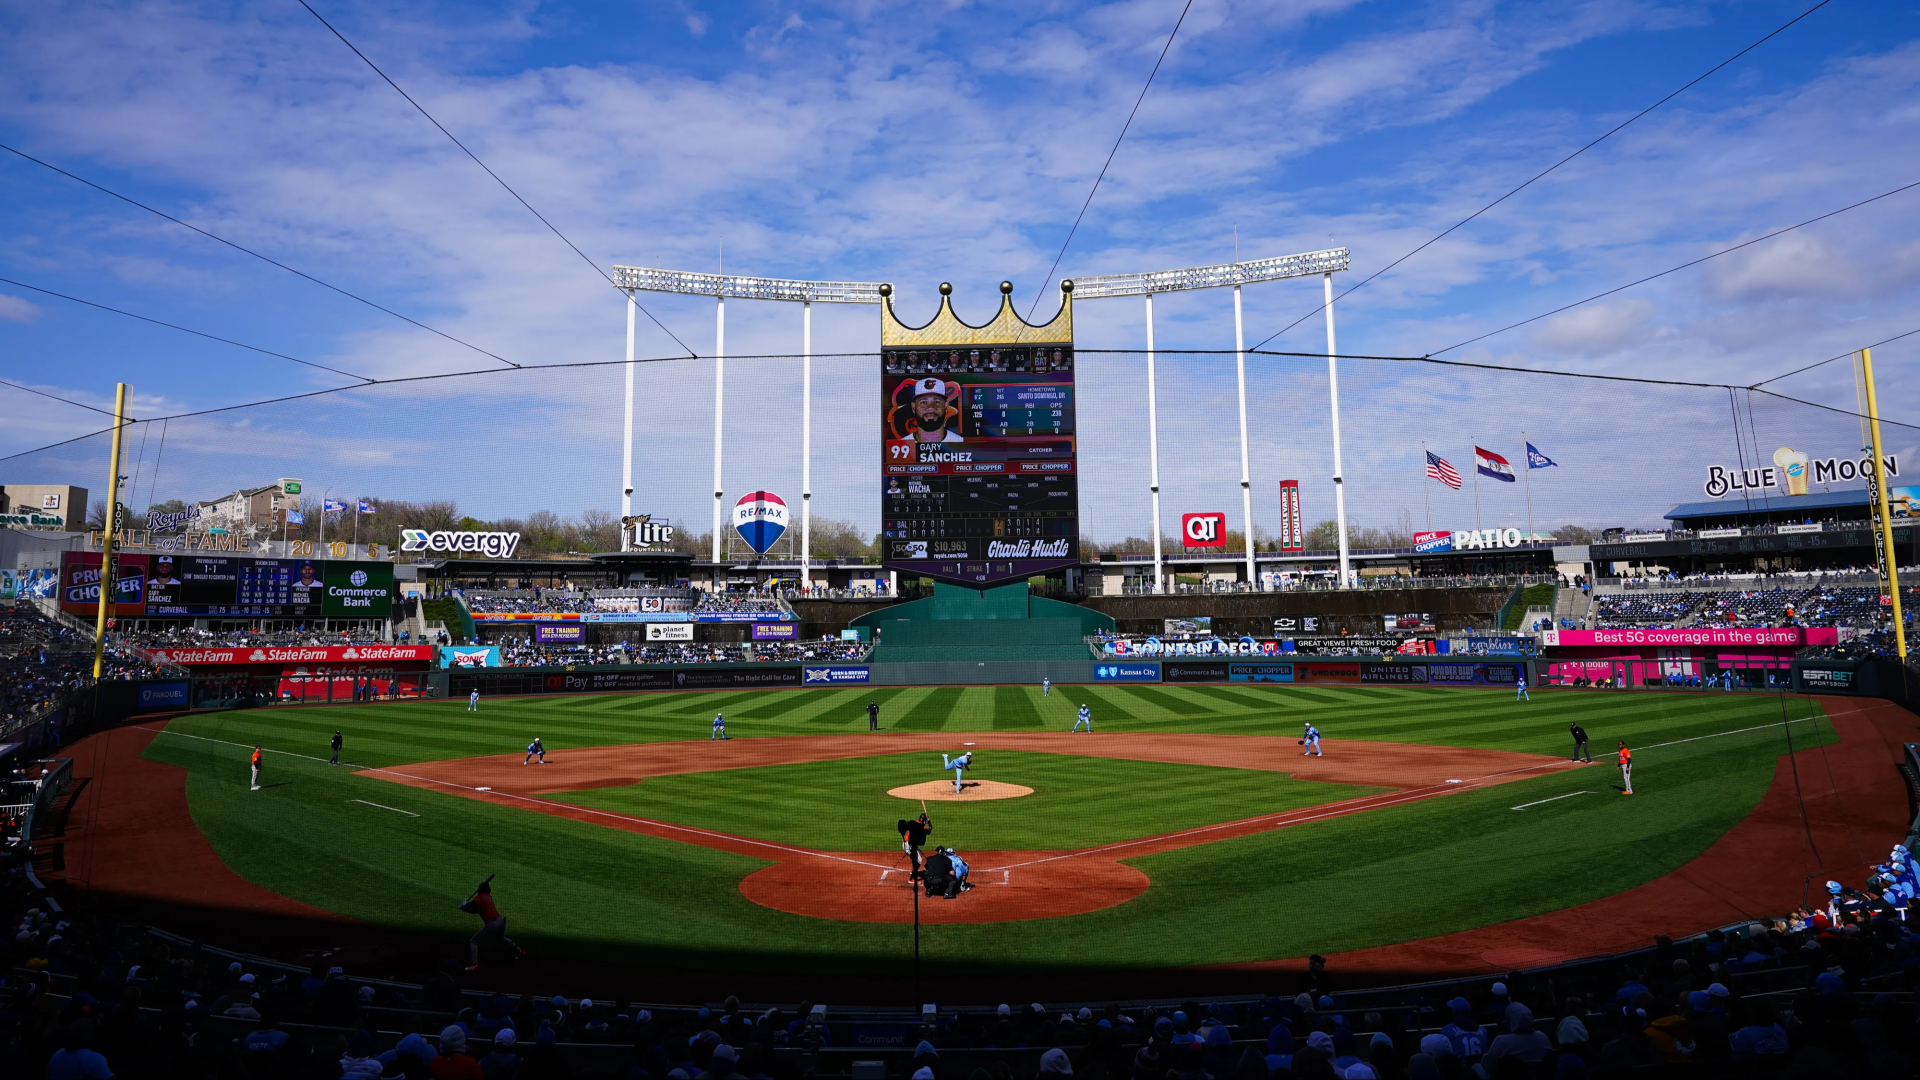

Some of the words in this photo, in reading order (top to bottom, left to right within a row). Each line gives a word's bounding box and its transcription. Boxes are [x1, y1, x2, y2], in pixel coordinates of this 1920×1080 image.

[1034, 357, 1047, 366] BAT
[891, 445, 910, 459] 99
[920, 450, 972, 462] SÁNCHEZ
[1706, 466, 1776, 497] BLUE
[1814, 456, 1898, 482] MOON
[909, 485, 930, 493] WACHA
[1869, 475, 1878, 506] ROOT
[113, 502, 123, 532] ROOT
[147, 506, 201, 531] Royals
[740, 507, 782, 518] RE/MAX
[1873, 514, 1881, 524] 4
[31, 514, 64, 525] Bank
[624, 514, 651, 528] Miller
[633, 522, 673, 548] Lite
[1187, 516, 1219, 541] QT
[90, 529, 158, 549] HALL
[162, 534, 178, 553] of
[184, 532, 250, 551] FAME
[1415, 532, 1438, 542] PRICE
[1455, 528, 1522, 551] PATIO
[1756, 538, 1768, 548] -10
[1808, 536, 1820, 546] -15
[292, 541, 313, 556] 20
[329, 542, 346, 557] 10
[368, 543, 378, 558] 5
[432, 535, 517, 556] evergy
[934, 541, 967, 552] $10,963
[988, 539, 1030, 558] Charlie
[1030, 539, 1069, 557] Hustle
[1415, 538, 1450, 551] CHOPPER
[1606, 546, 1648, 556] CURVEBALL
[1706, 542, 1717, 551] 75
[1876, 532, 1887, 580] CHIKIN
[956, 563, 961, 574] 1
[985, 562, 990, 574] 1
[1008, 562, 1013, 574] 1
[109, 558, 118, 602] CHIKIN
[70, 580, 141, 601] CHOPER
[329, 586, 387, 597] Commerce
[344, 597, 371, 607] Bank
[1594, 632, 1623, 643] Best
[1626, 632, 1645, 643] 5G
[1648, 631, 1710, 644] coverage
[1713, 631, 1725, 642] in
[1728, 631, 1752, 642] the
[1755, 632, 1797, 645] game
[1133, 642, 1213, 654] FOUNTAIN
[1217, 642, 1260, 653] DECK
[457, 655, 485, 664] SONIC
[1665, 649, 1682, 668] T
[1430, 666, 1458, 675] POWDER
[1458, 666, 1474, 675] BLUE
[1802, 670, 1832, 680] ESPN
[1833, 671, 1854, 681] BET
[547, 676, 563, 689] QT
[566, 676, 588, 691] Pay
[1462, 1036, 1482, 1057] 16
